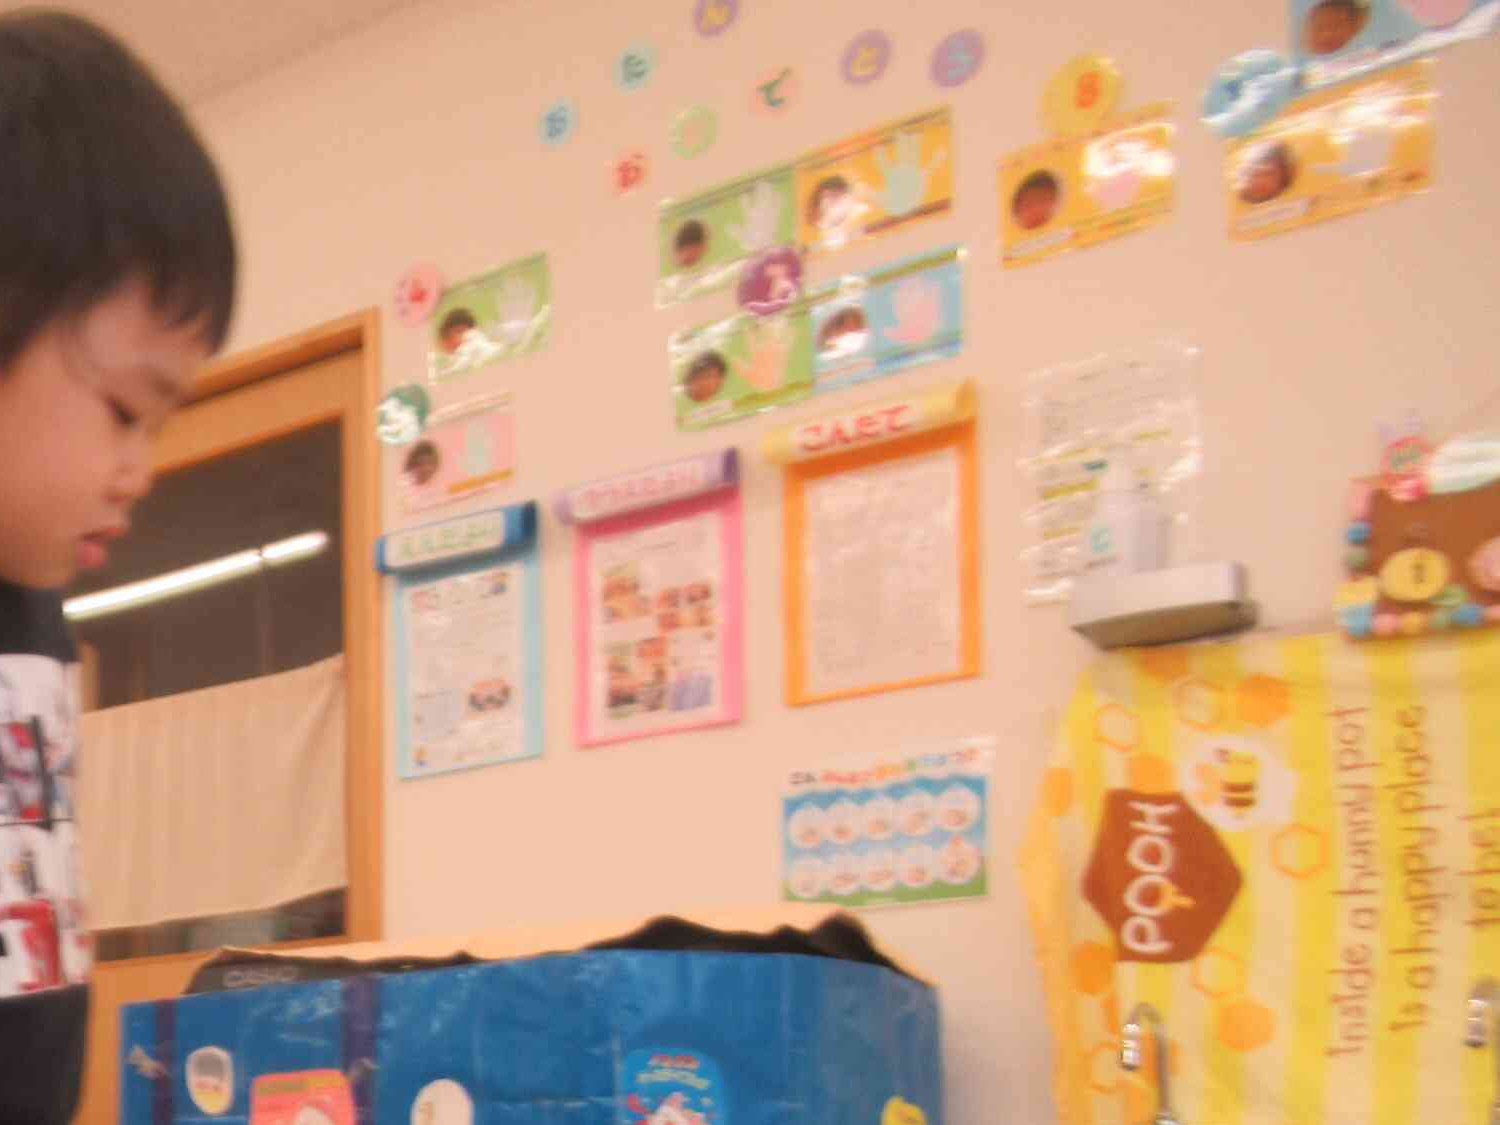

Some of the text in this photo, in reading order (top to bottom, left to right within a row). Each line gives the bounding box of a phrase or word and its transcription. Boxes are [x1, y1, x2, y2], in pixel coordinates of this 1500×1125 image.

[1323, 706, 1386, 773] pot
[1121, 800, 1181, 954] POOH
[1386, 825, 1450, 956] happy
